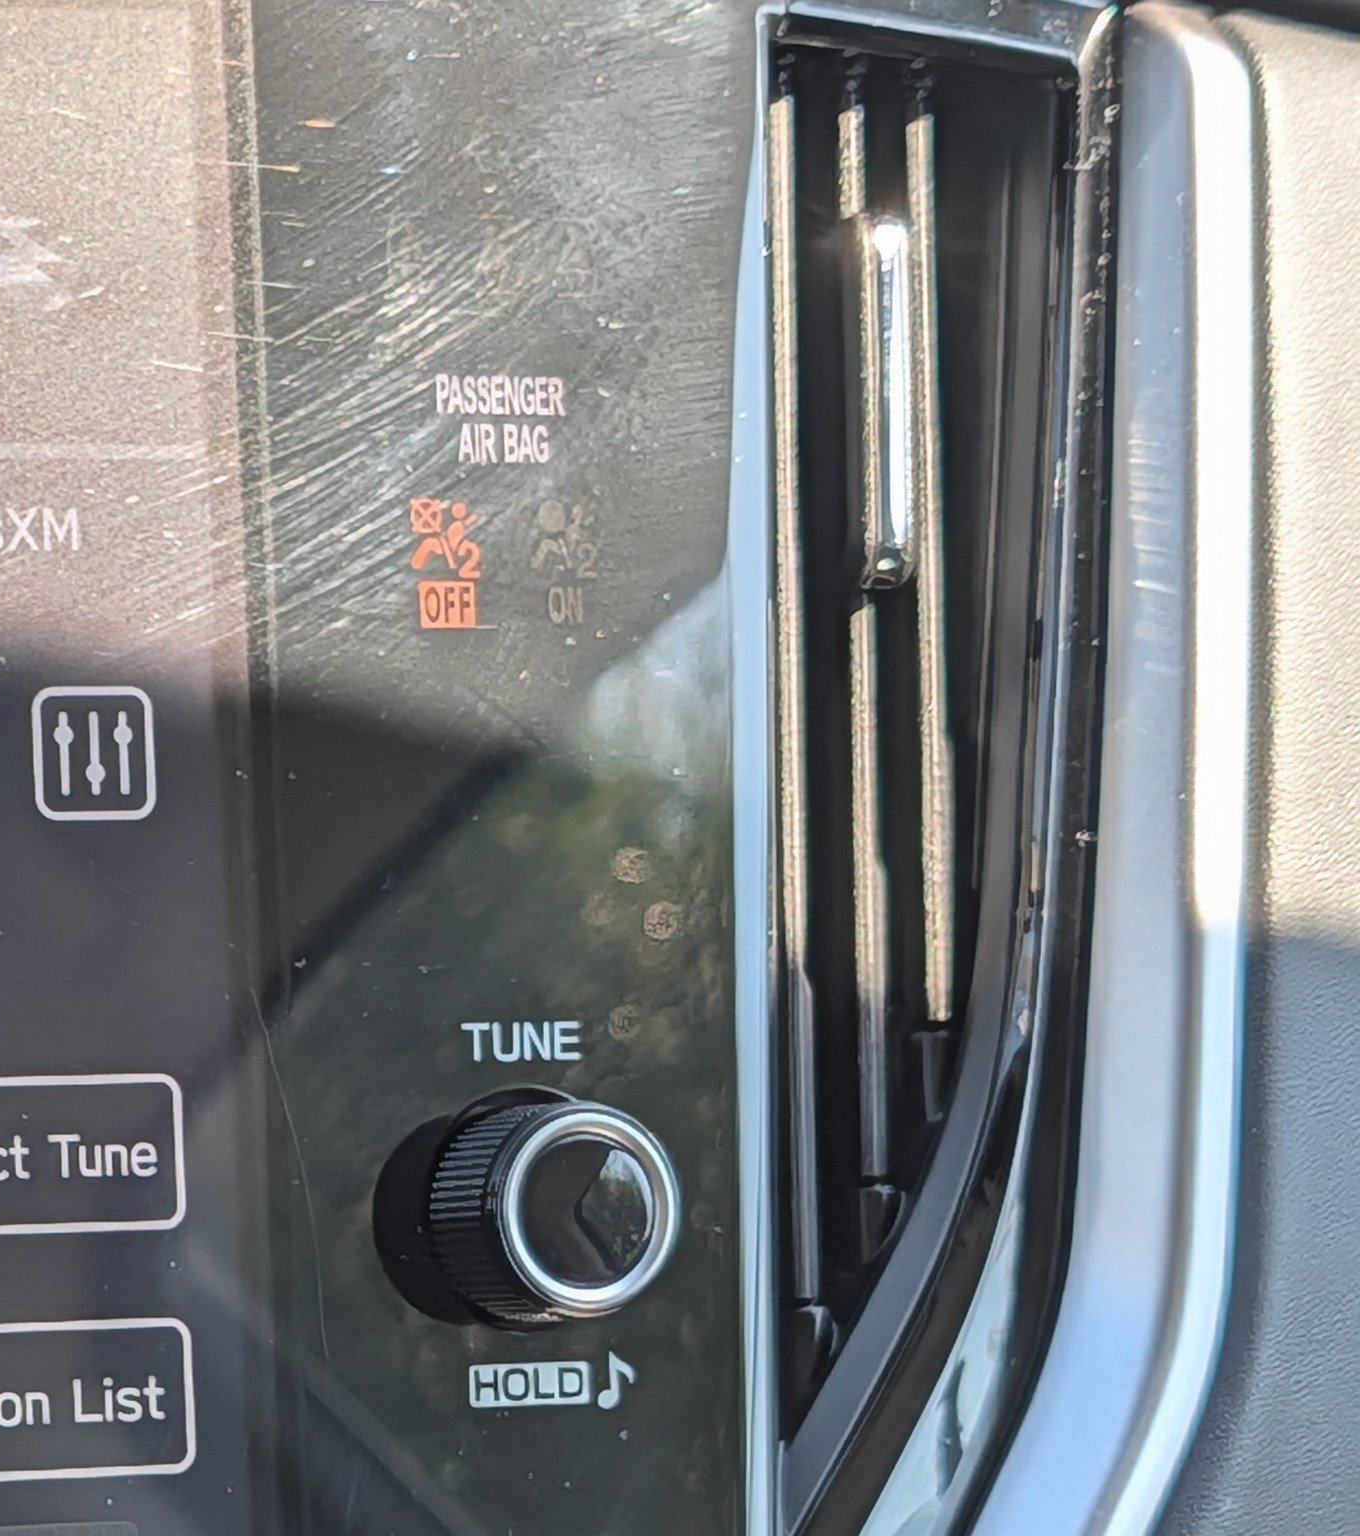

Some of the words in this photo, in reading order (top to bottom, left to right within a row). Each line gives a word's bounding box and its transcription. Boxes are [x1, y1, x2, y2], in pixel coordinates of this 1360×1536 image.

[435, 374, 565, 418] PASSENGER
[458, 423, 497, 463] AIR
[502, 424, 549, 463] BAG
[423, 584, 474, 626] OFF
[548, 586, 584, 623] ON
[461, 1020, 583, 1063] TUNE
[47, 1132, 159, 1179] Tune
[72, 1376, 166, 1425] List
[473, 1366, 586, 1404] HOLD
